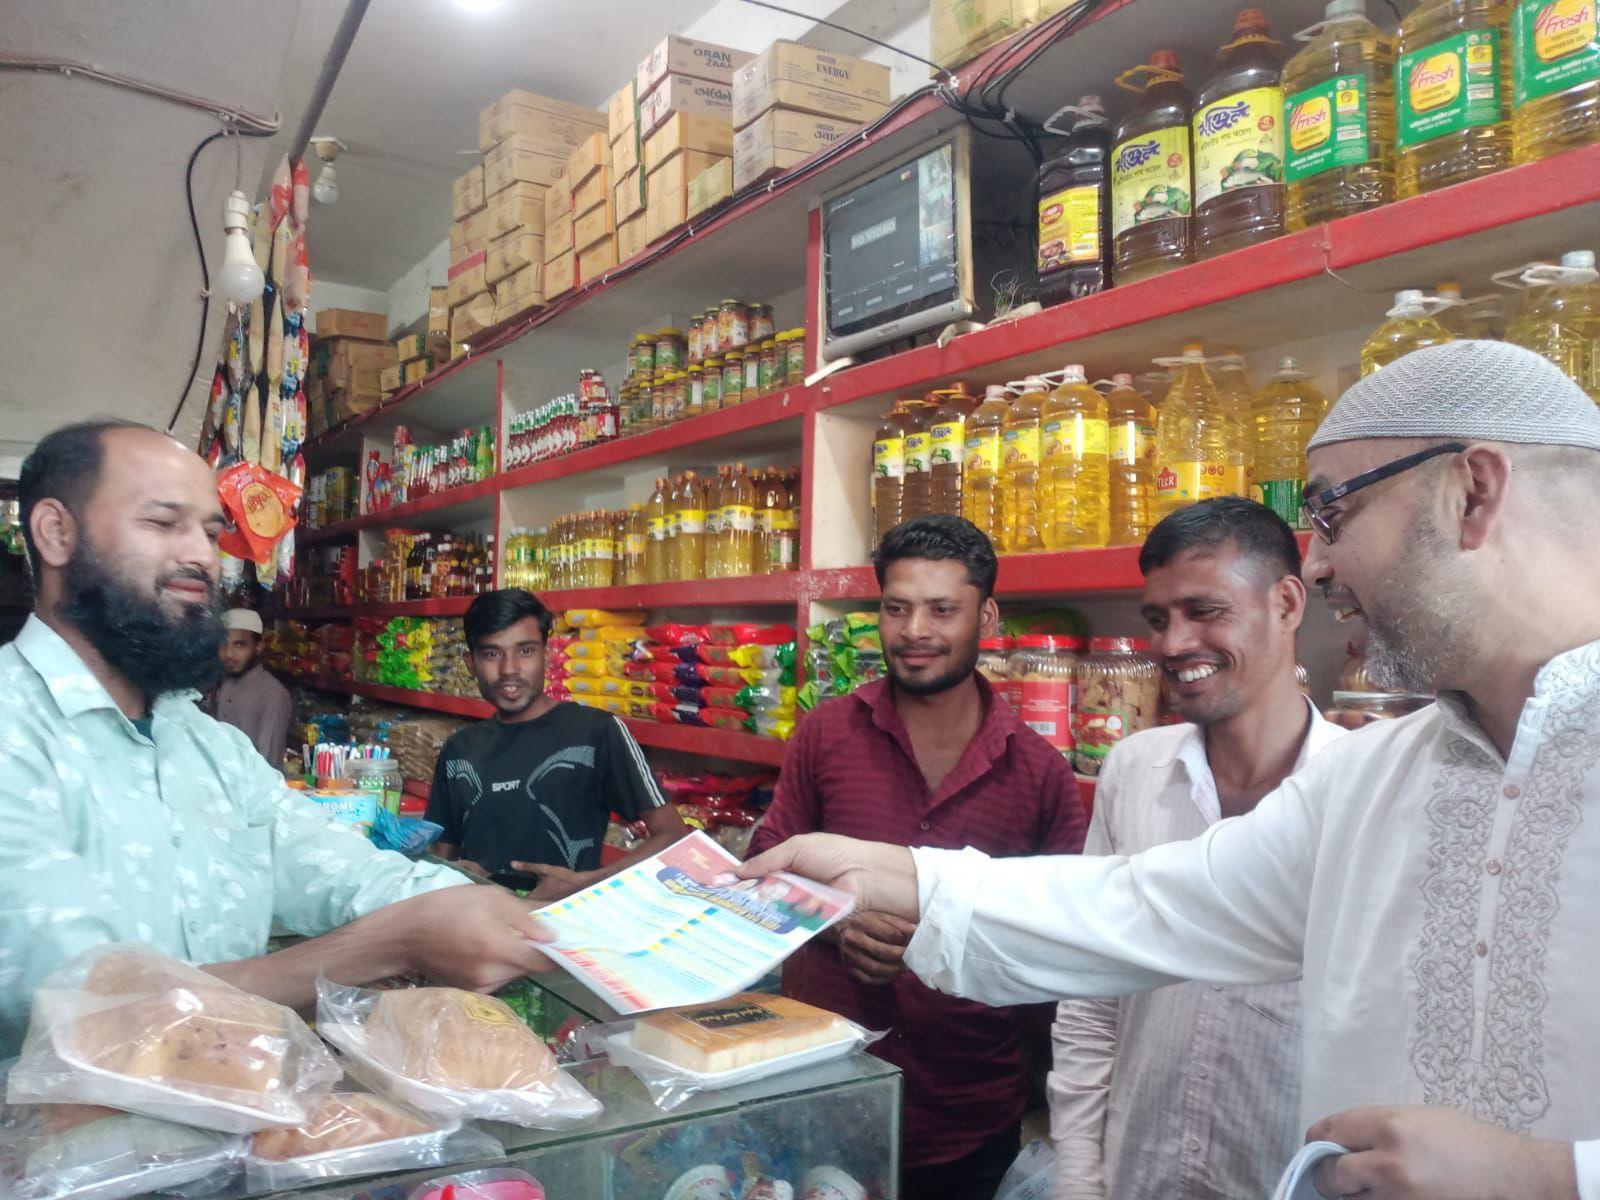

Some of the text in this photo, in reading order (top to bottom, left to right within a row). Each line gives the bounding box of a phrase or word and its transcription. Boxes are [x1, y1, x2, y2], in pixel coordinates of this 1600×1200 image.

[1544, 7, 1588, 36] Fresh
[817, 63, 850, 80] ENERGY
[1418, 64, 1454, 88] Fresh
[1296, 107, 1327, 130] Fresh
[866, 222, 896, 242] VIDEO
[491, 779, 521, 792] SPORT
